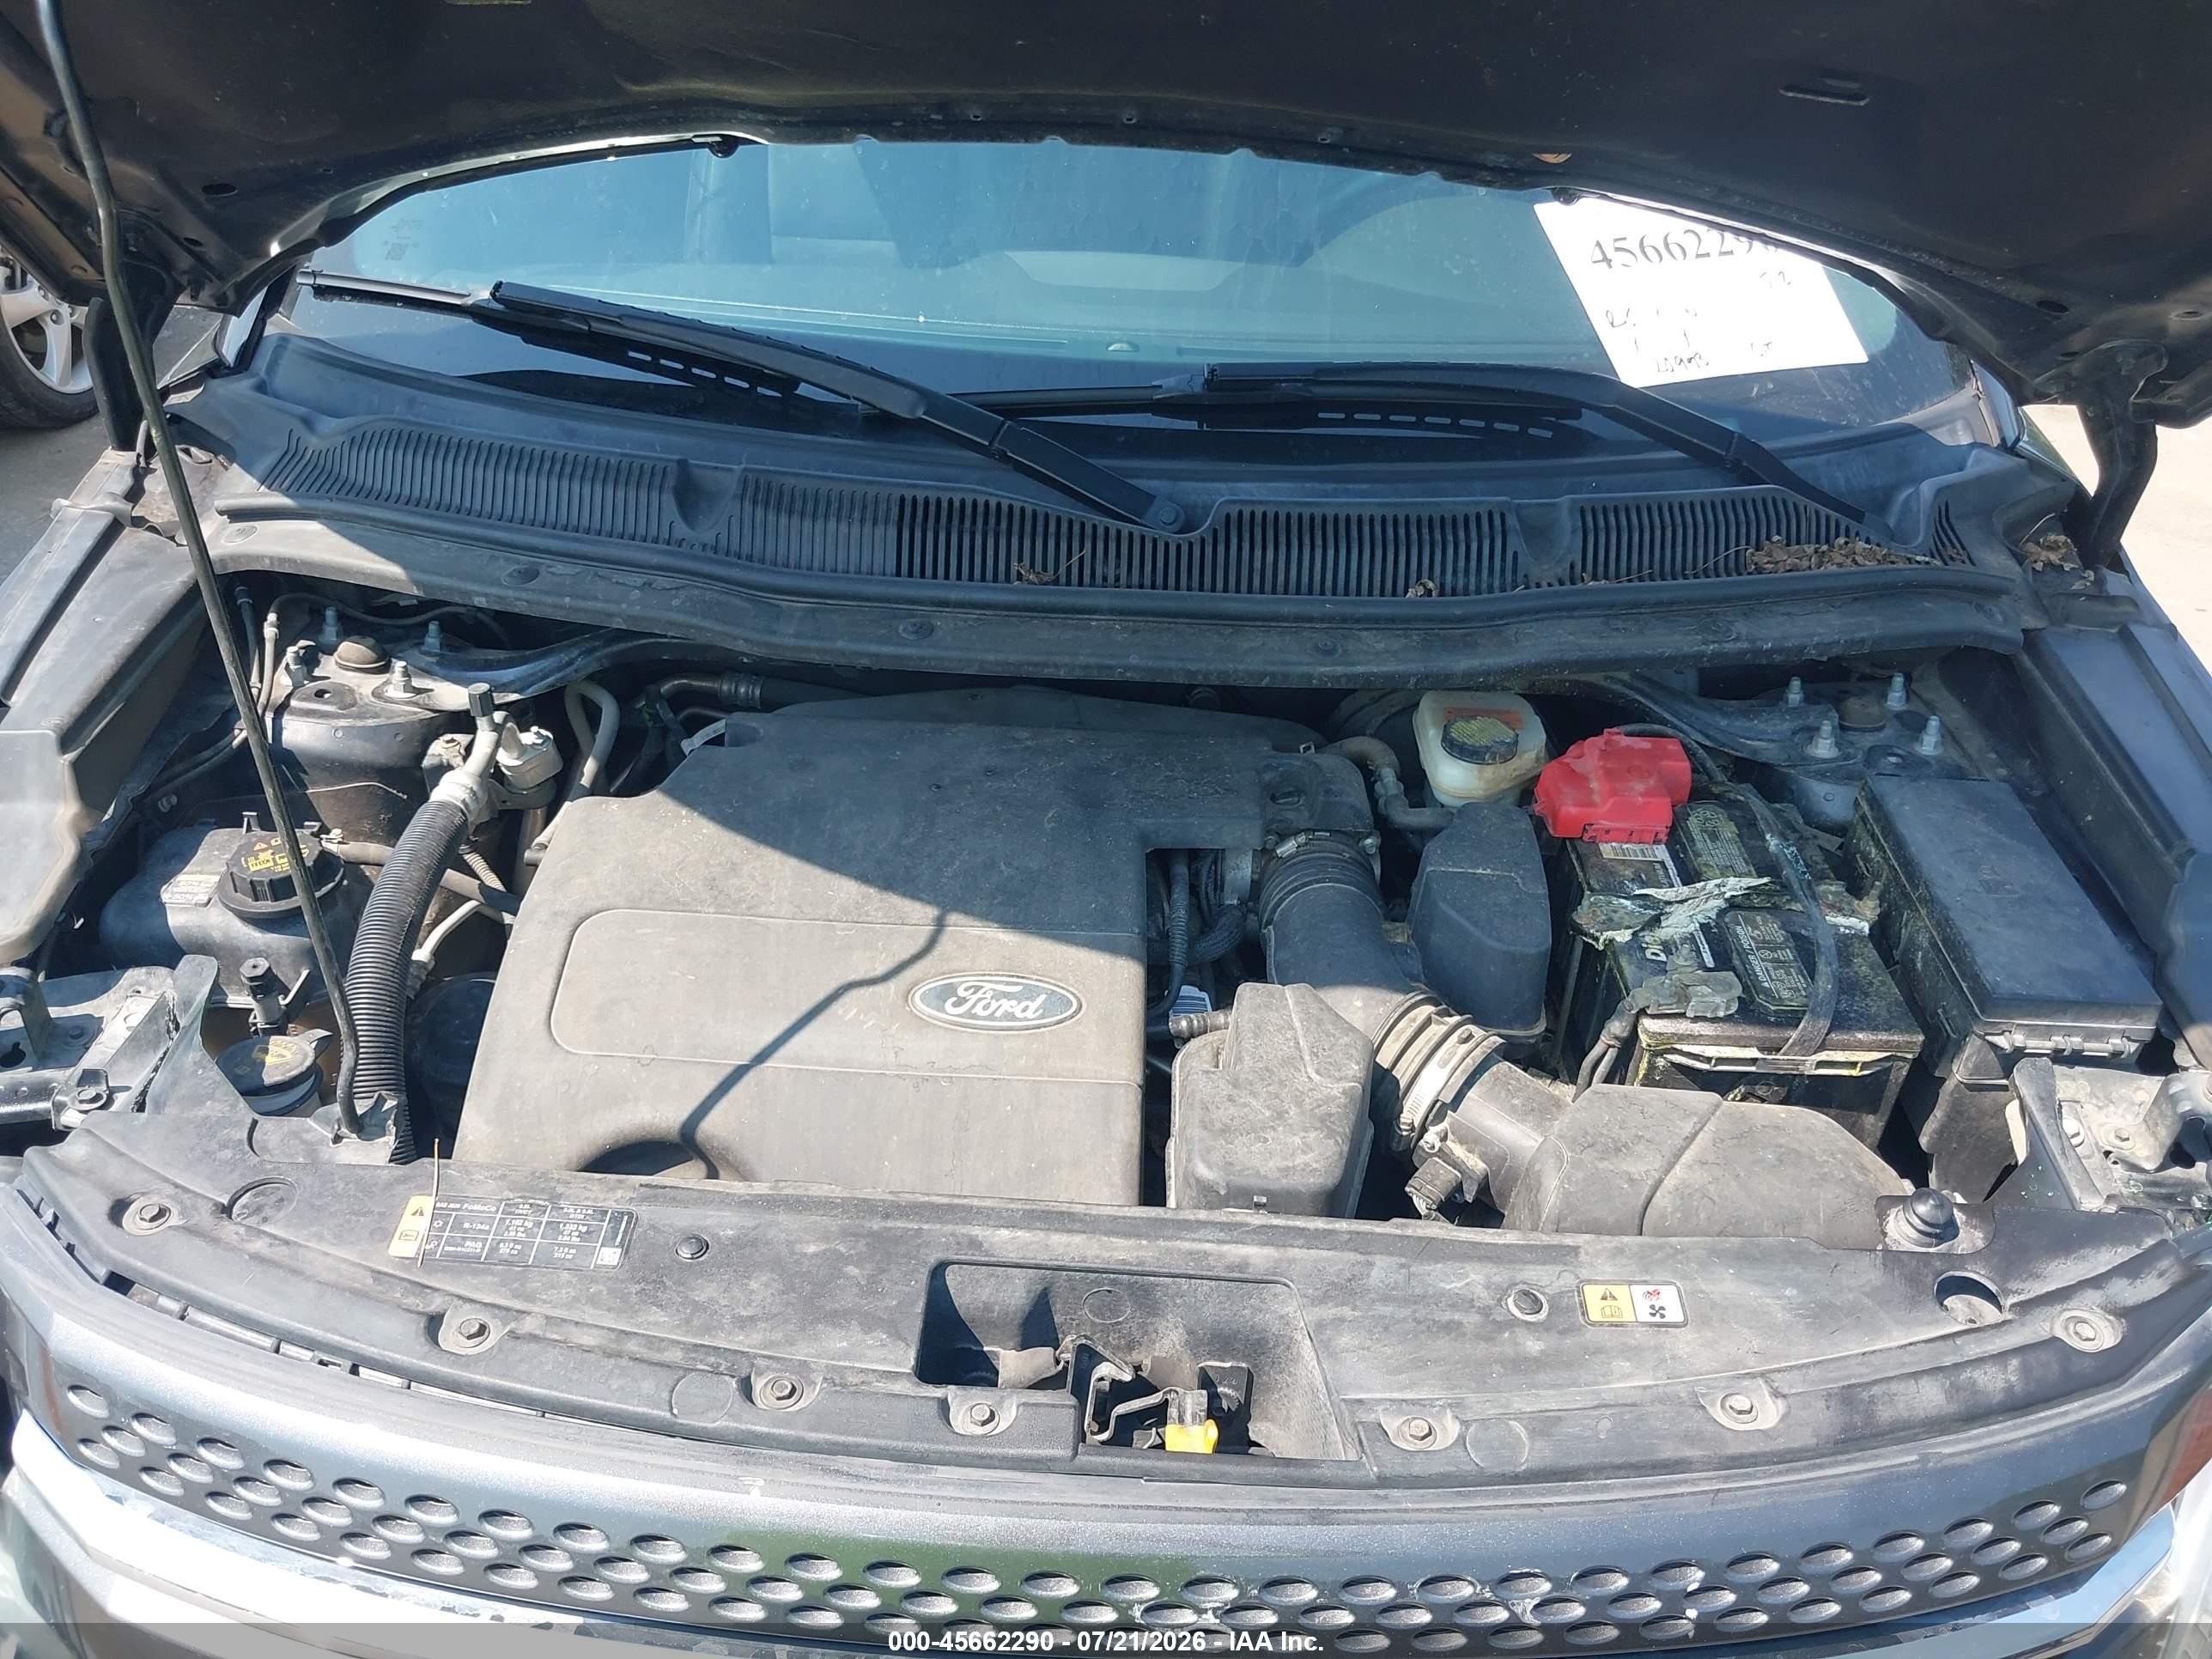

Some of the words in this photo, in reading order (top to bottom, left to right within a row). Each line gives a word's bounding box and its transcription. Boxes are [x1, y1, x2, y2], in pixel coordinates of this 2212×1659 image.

[1735, 925, 1753, 949] POISON
[1747, 954, 1766, 981] DANGER
[944, 981, 1048, 1020] Ford
[462, 1203, 497, 1212] FoMoCo
